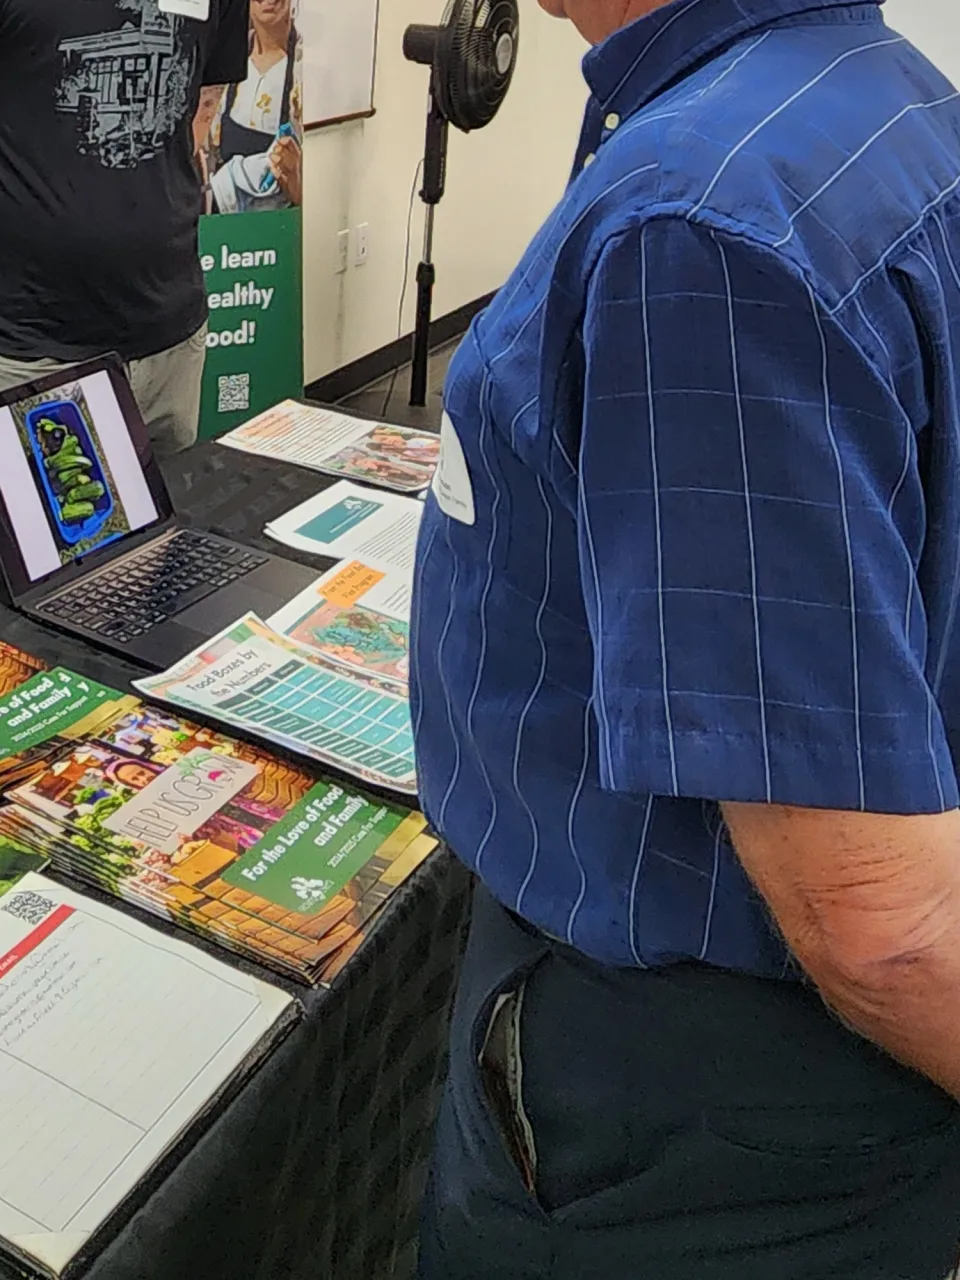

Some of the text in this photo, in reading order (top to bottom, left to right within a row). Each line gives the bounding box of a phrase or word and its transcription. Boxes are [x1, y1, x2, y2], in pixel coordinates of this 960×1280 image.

[200, 245, 276, 270] e learn
[207, 281, 274, 309] ealthy
[206, 320, 256, 347] ood!
[186, 649, 258, 690] Food Boxes by
[225, 662, 272, 689] Numbers
[7, 709, 33, 727] and
[32, 686, 71, 713] Family
[9, 695, 24, 708] of
[21, 677, 54, 701] Food
[241, 783, 343, 881] For the Love of Food
[314, 794, 369, 847] and Family
